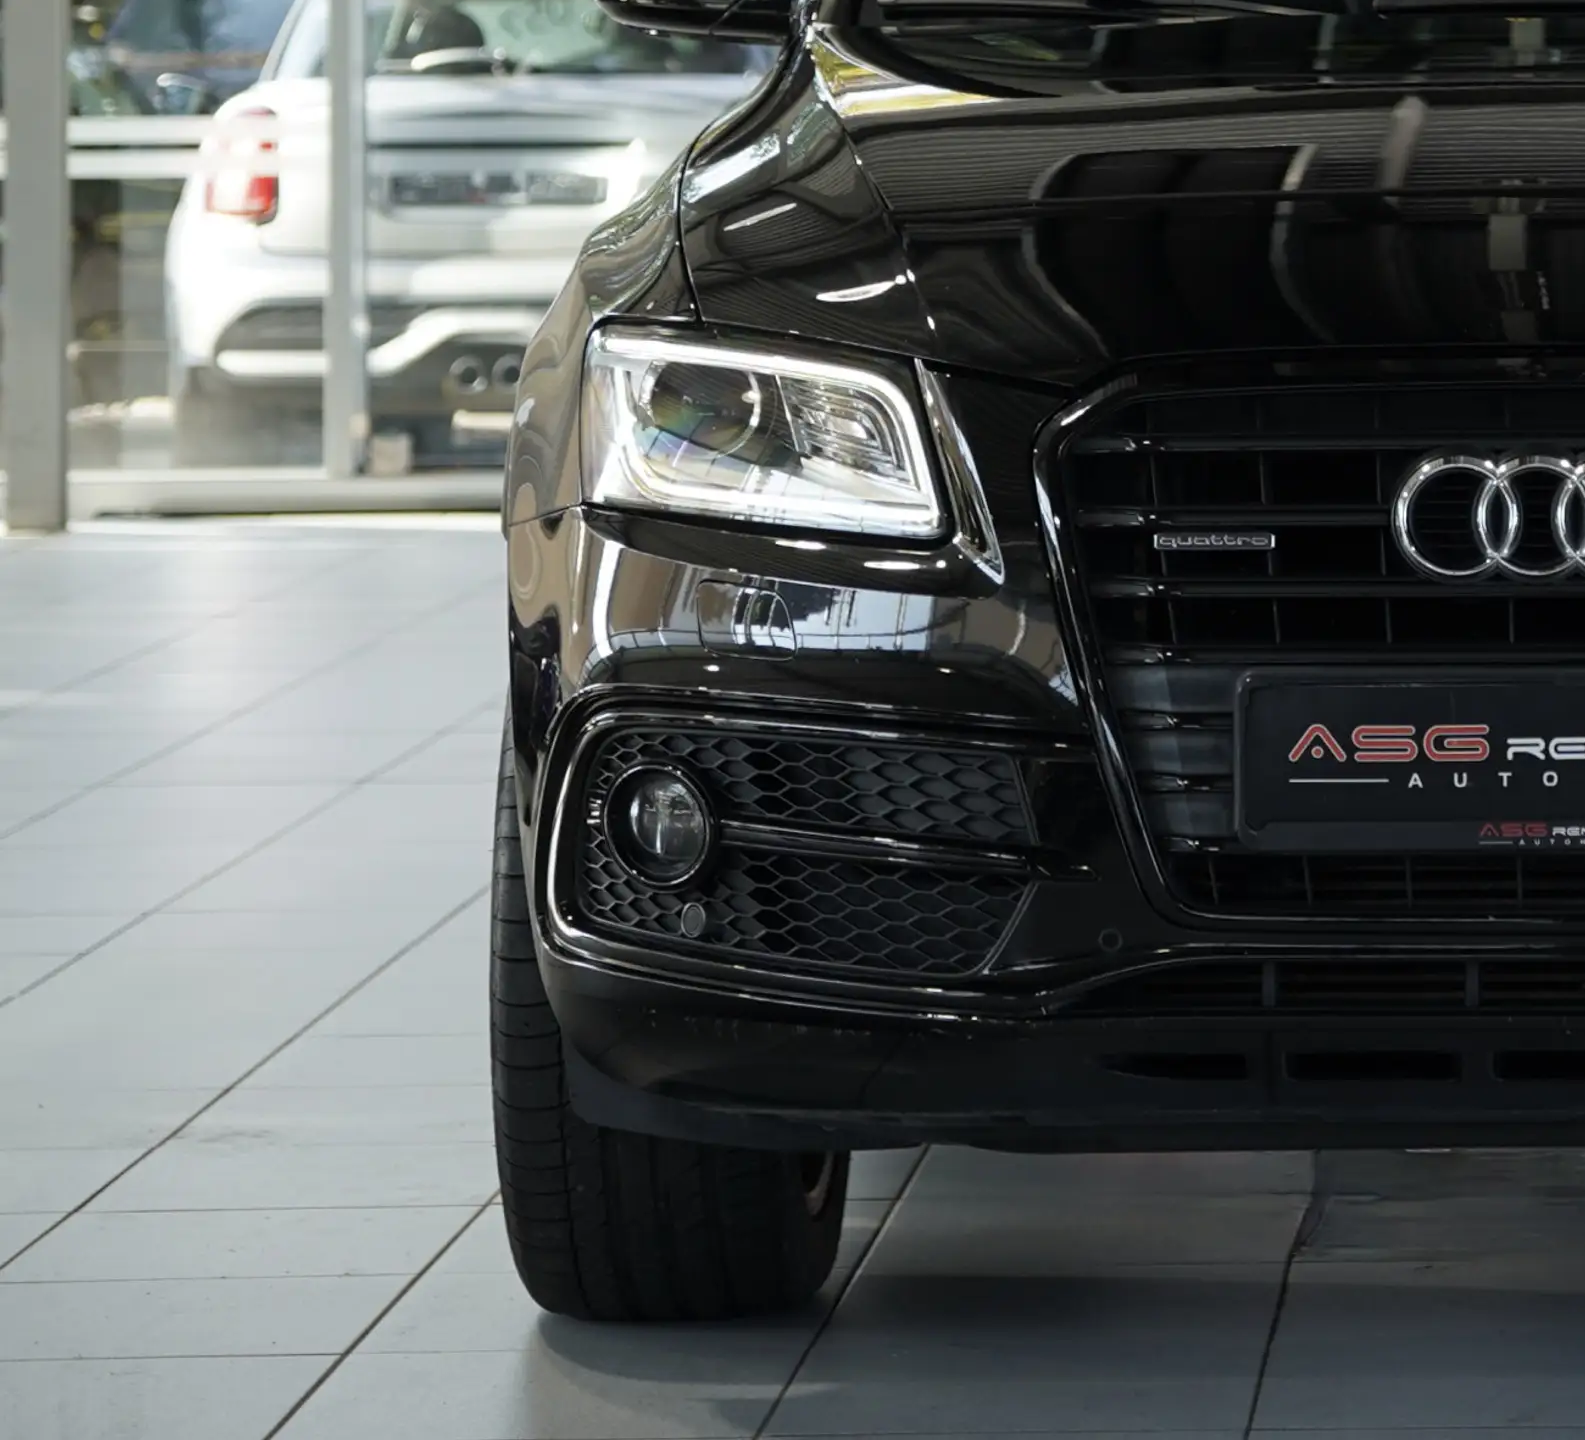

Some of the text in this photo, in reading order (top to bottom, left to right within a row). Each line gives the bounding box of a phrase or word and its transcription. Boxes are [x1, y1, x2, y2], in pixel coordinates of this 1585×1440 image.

[1158, 534, 1269, 548] quattro
[1288, 724, 1489, 762] ASG
[1479, 823, 1548, 837] ASG
